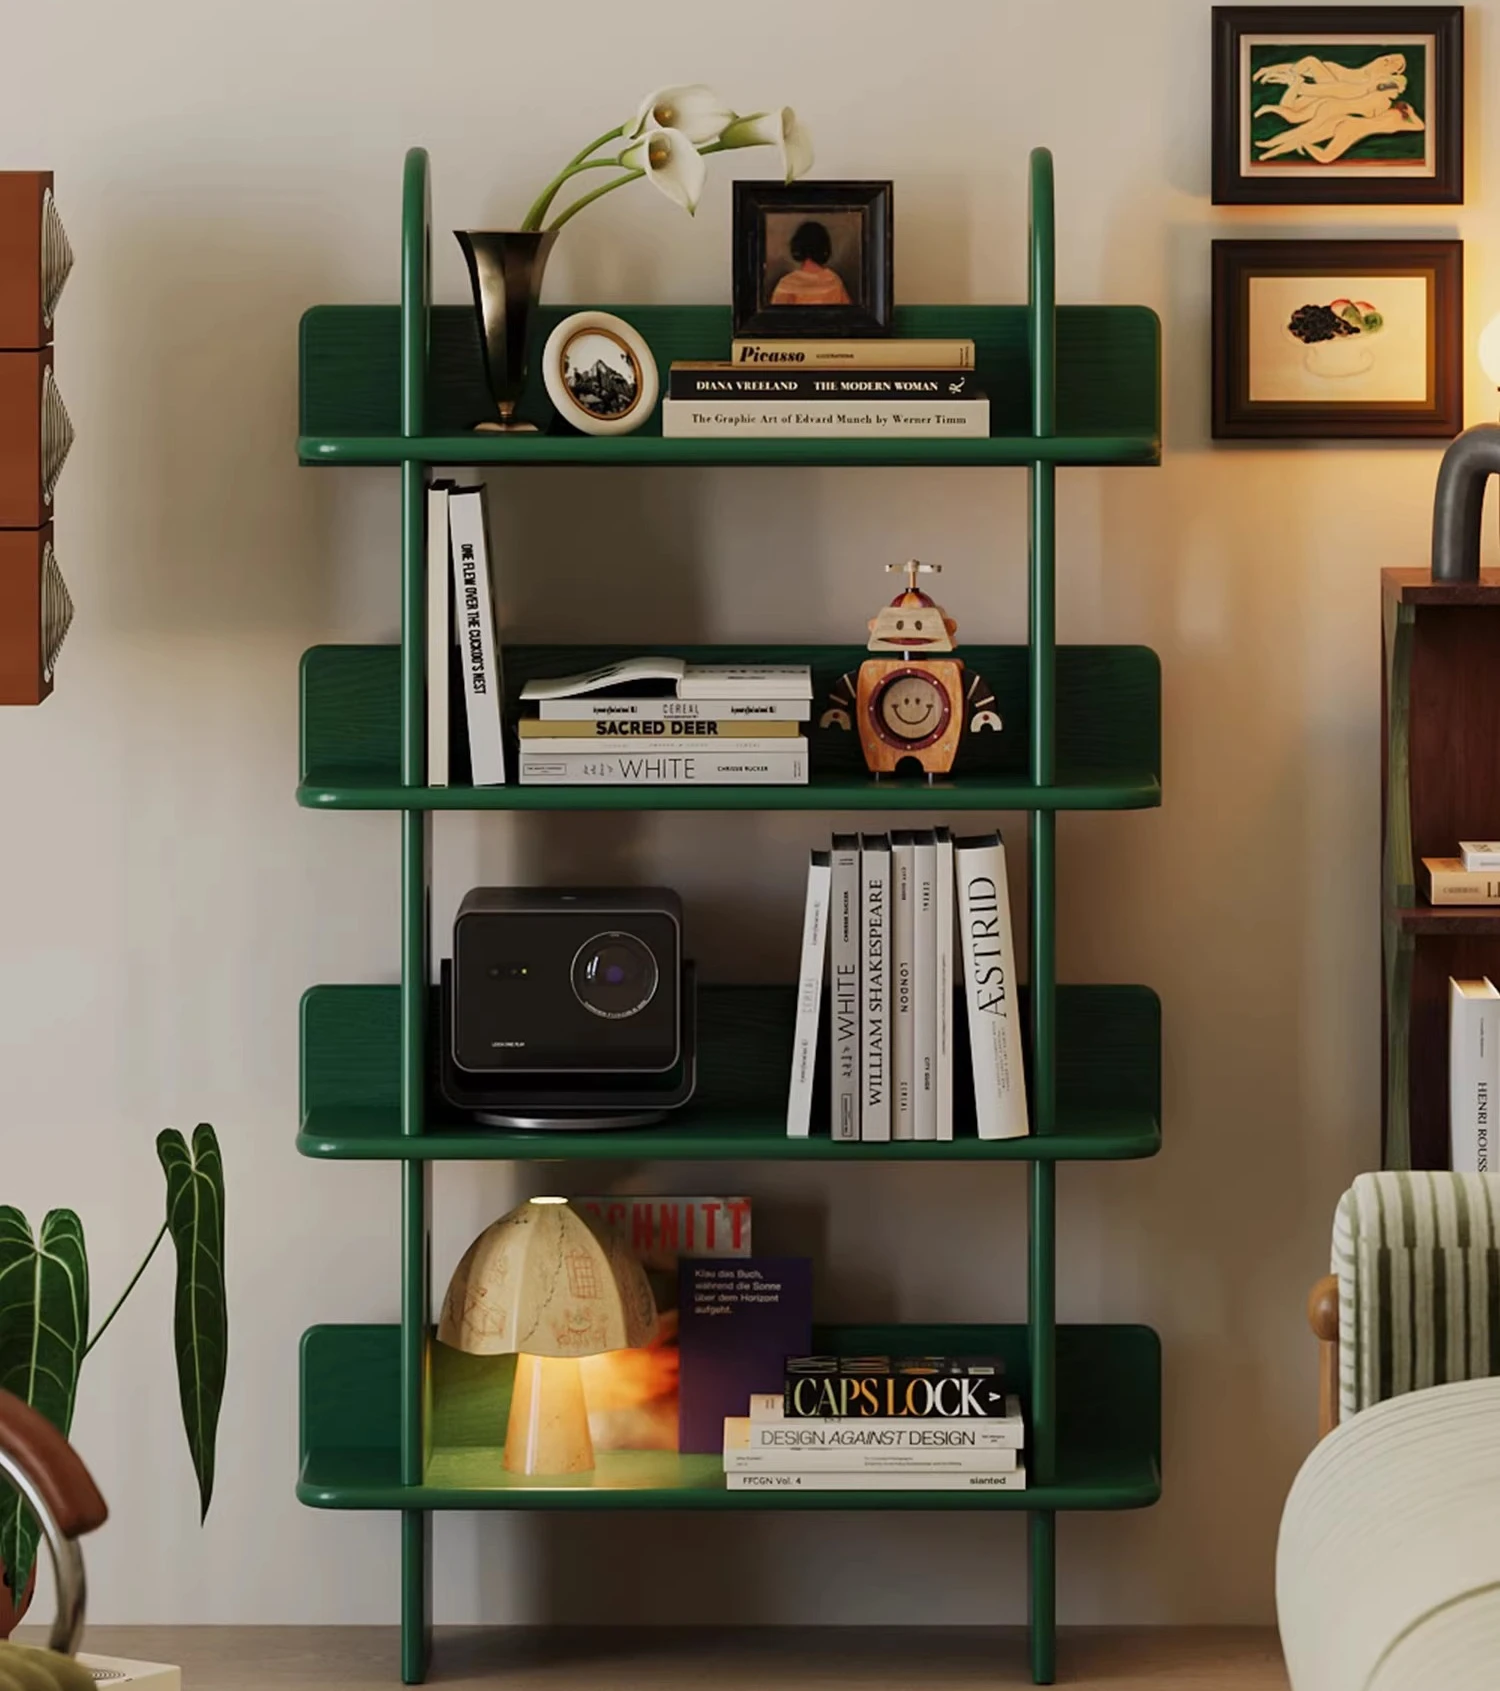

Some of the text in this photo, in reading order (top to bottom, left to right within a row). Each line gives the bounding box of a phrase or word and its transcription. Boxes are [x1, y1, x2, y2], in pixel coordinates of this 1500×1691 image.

[740, 346, 805, 363] Picasso
[696, 381, 938, 391] DIANA VREELAND THE MODERN WOMAN
[692, 414, 967, 427] The Graphic Art of Edvard Munch by Werner Timm
[461, 544, 486, 695] ONE FLEW OVER THE CUCKOO'S NEST
[663, 704, 700, 714] CEREAL
[596, 721, 718, 736] SACRED DEER
[618, 758, 695, 779] WHITE
[869, 879, 883, 1106] WILLIAM SHAKESPEARE
[900, 962, 909, 1013] LONDON
[837, 964, 855, 1042] WHITE
[1478, 1081, 1488, 1125] HENRI
[695, 1269, 764, 1279] Klau das Buch,
[736, 1281, 751, 1290] die
[753, 1281, 781, 1291] Sonne
[695, 1293, 779, 1303] über dem Horizont
[794, 1378, 880, 1416] CAPS
[887, 1378, 988, 1416] LOCK
[761, 1430, 826, 1445] DESIGN
[828, 1430, 906, 1445] AGAINST
[909, 1430, 975, 1445] DESIGN
[775, 1477, 793, 1485] Vol.
[795, 1477, 802, 1485] 4
[970, 1477, 1006, 1485] slanted
